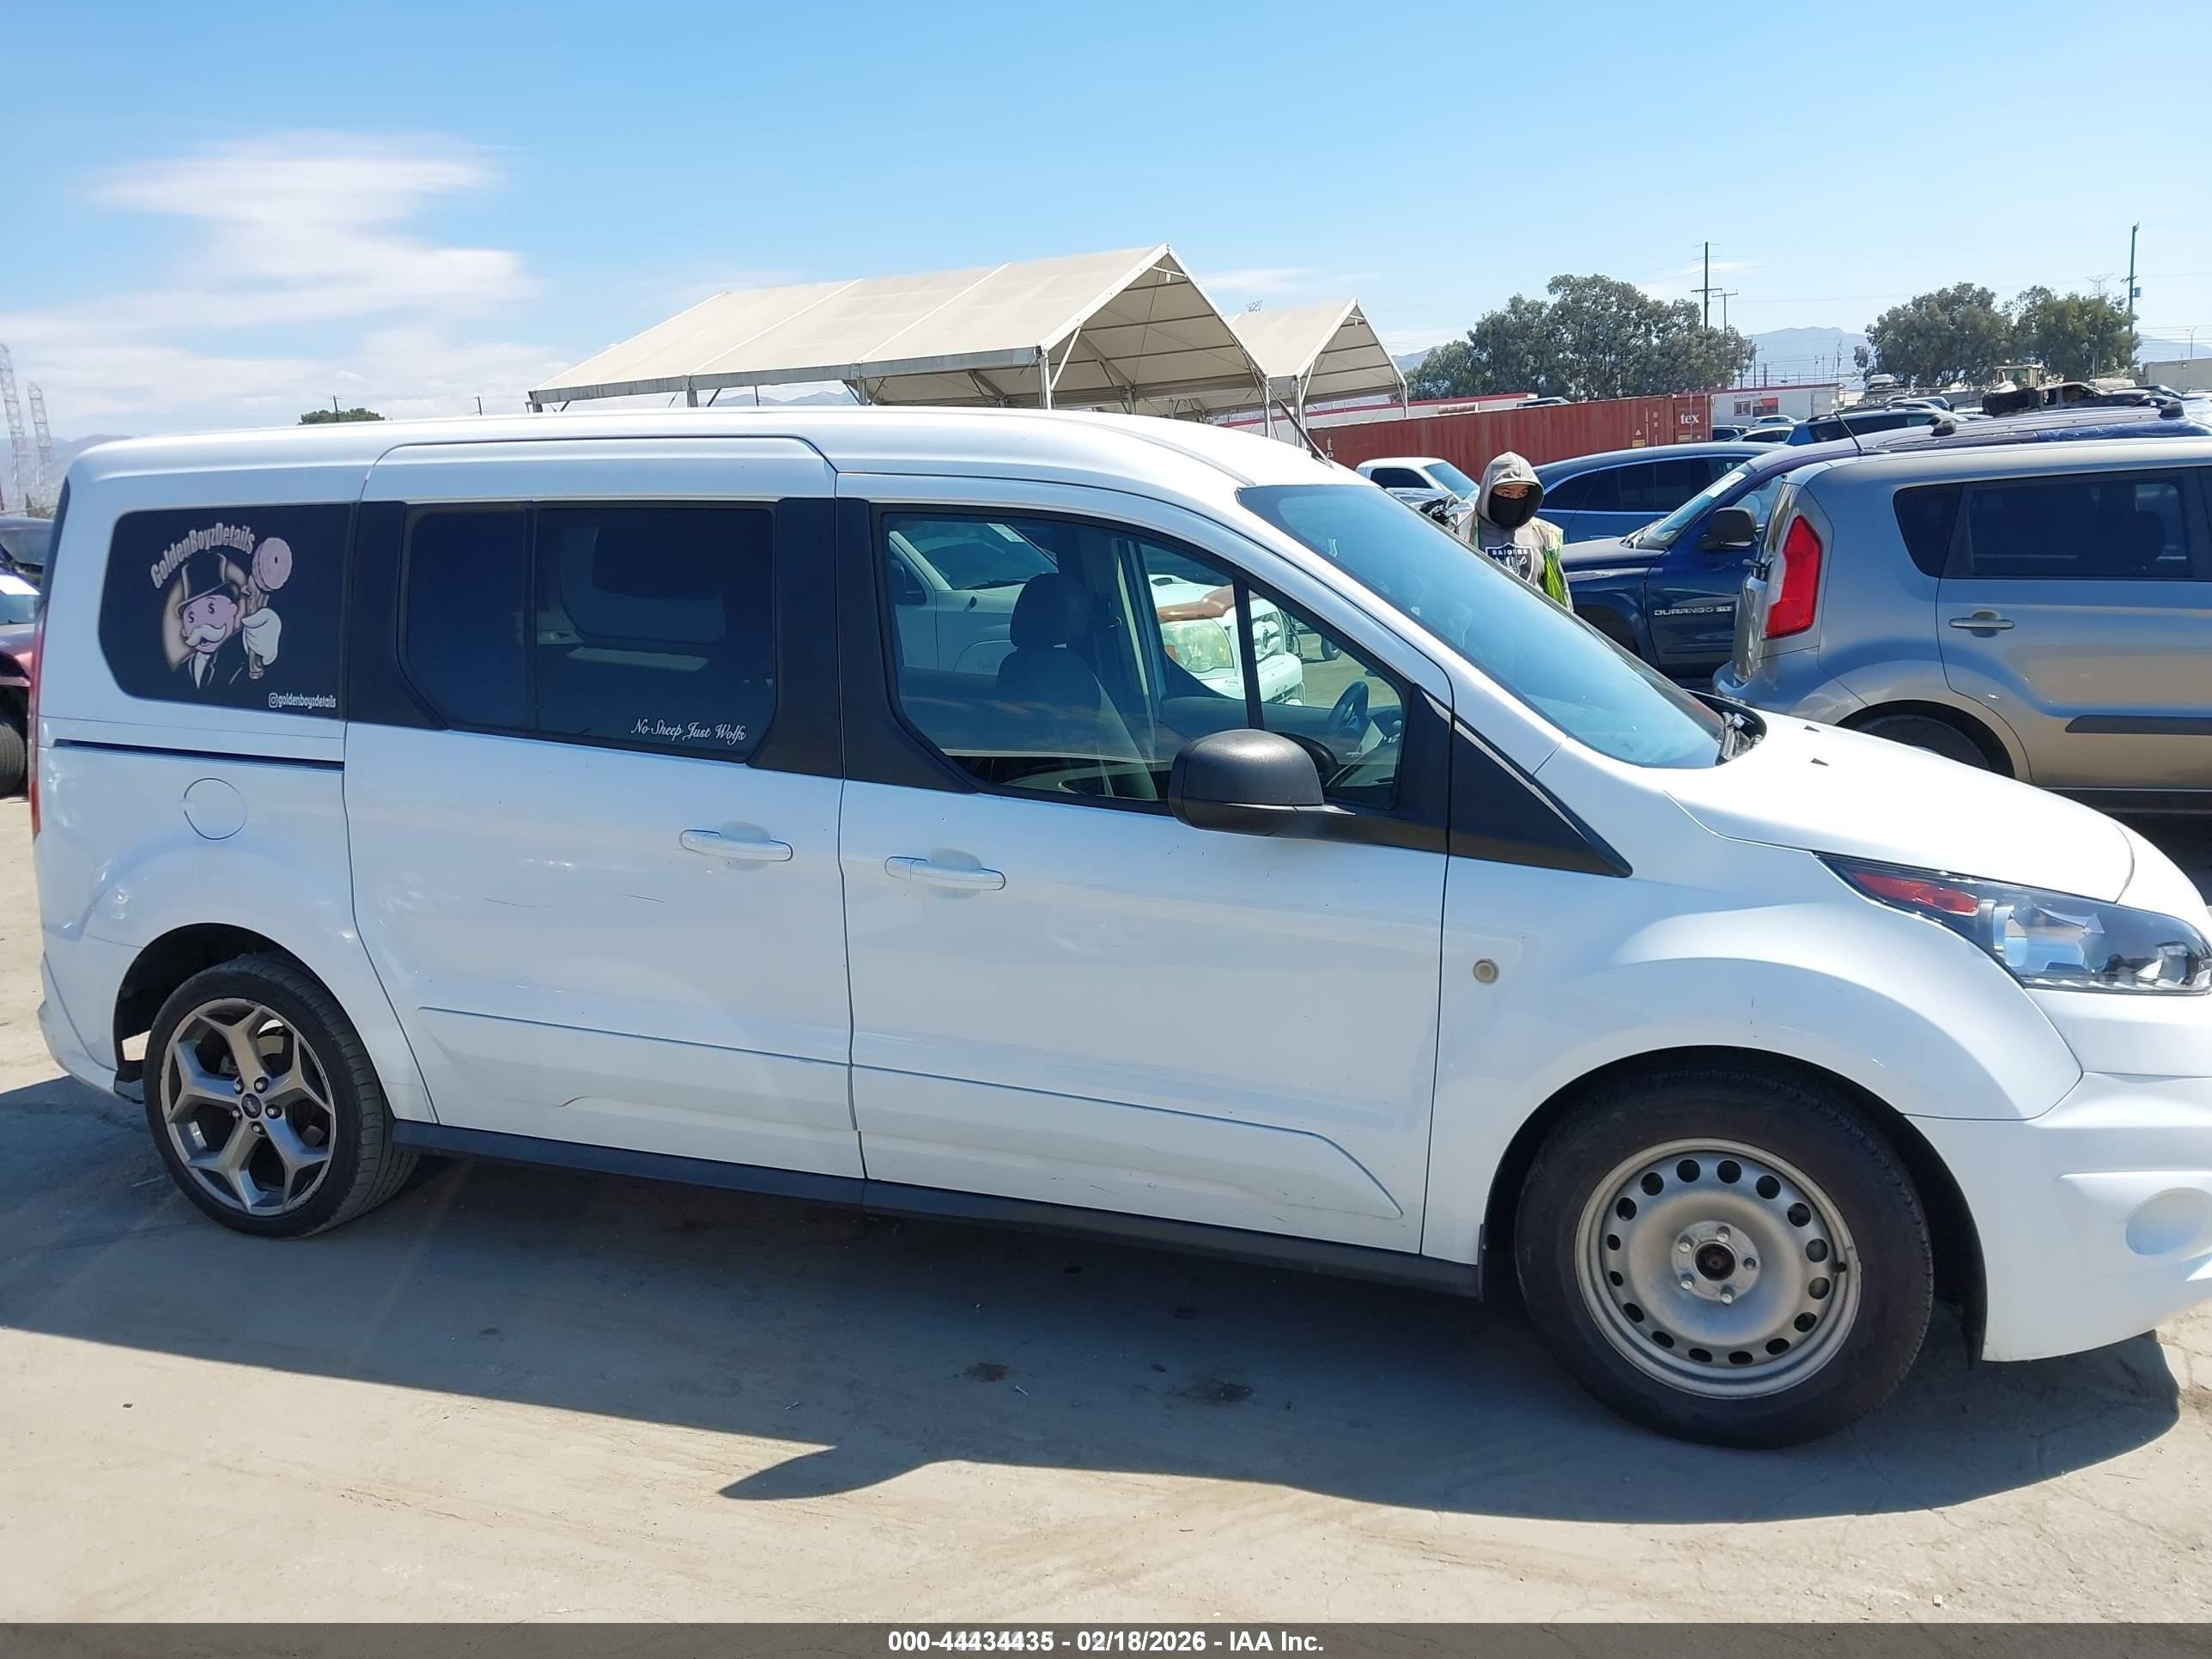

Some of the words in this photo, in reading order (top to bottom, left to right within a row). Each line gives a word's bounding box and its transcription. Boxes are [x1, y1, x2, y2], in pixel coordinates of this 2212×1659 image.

[1680, 412, 1700, 424] tex
[150, 522, 255, 589] GoldenBoyzDetails
[1654, 606, 1714, 616] DURANGO
[631, 718, 650, 734] No
[651, 719, 684, 742] Sheep
[682, 721, 712, 741] Just
[714, 723, 747, 746] Wolfs
